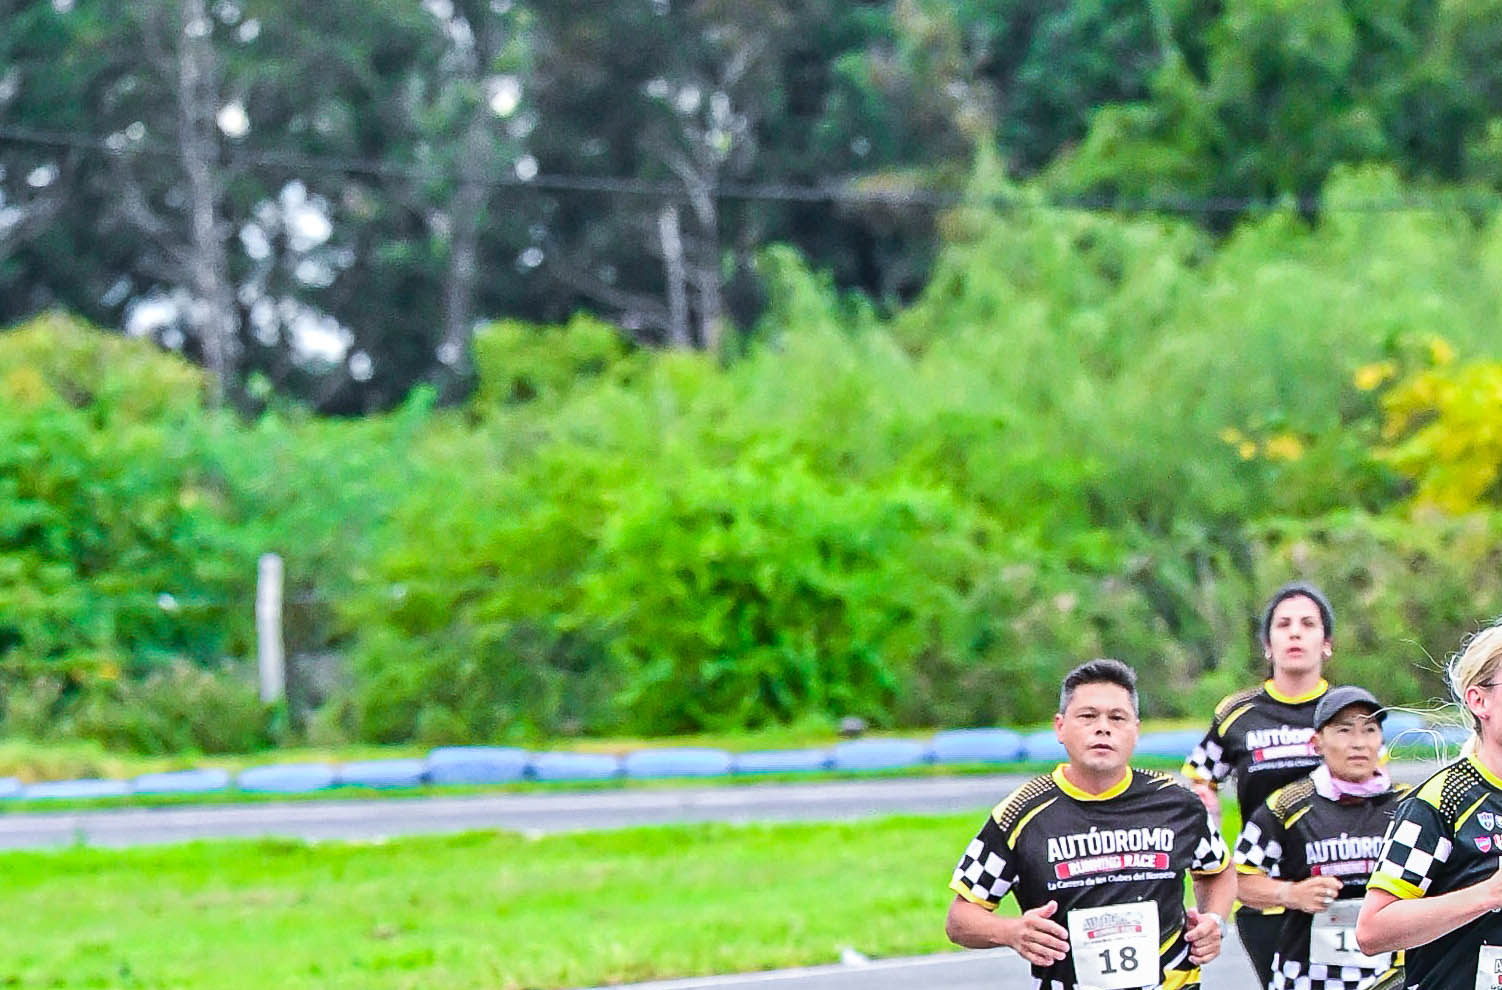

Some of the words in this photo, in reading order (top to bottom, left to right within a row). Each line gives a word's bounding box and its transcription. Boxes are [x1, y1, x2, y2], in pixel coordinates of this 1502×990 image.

[1047, 826, 1175, 862] AUTÓDROMO
[1123, 853, 1156, 868] RACE
[1099, 946, 1139, 975] 18
